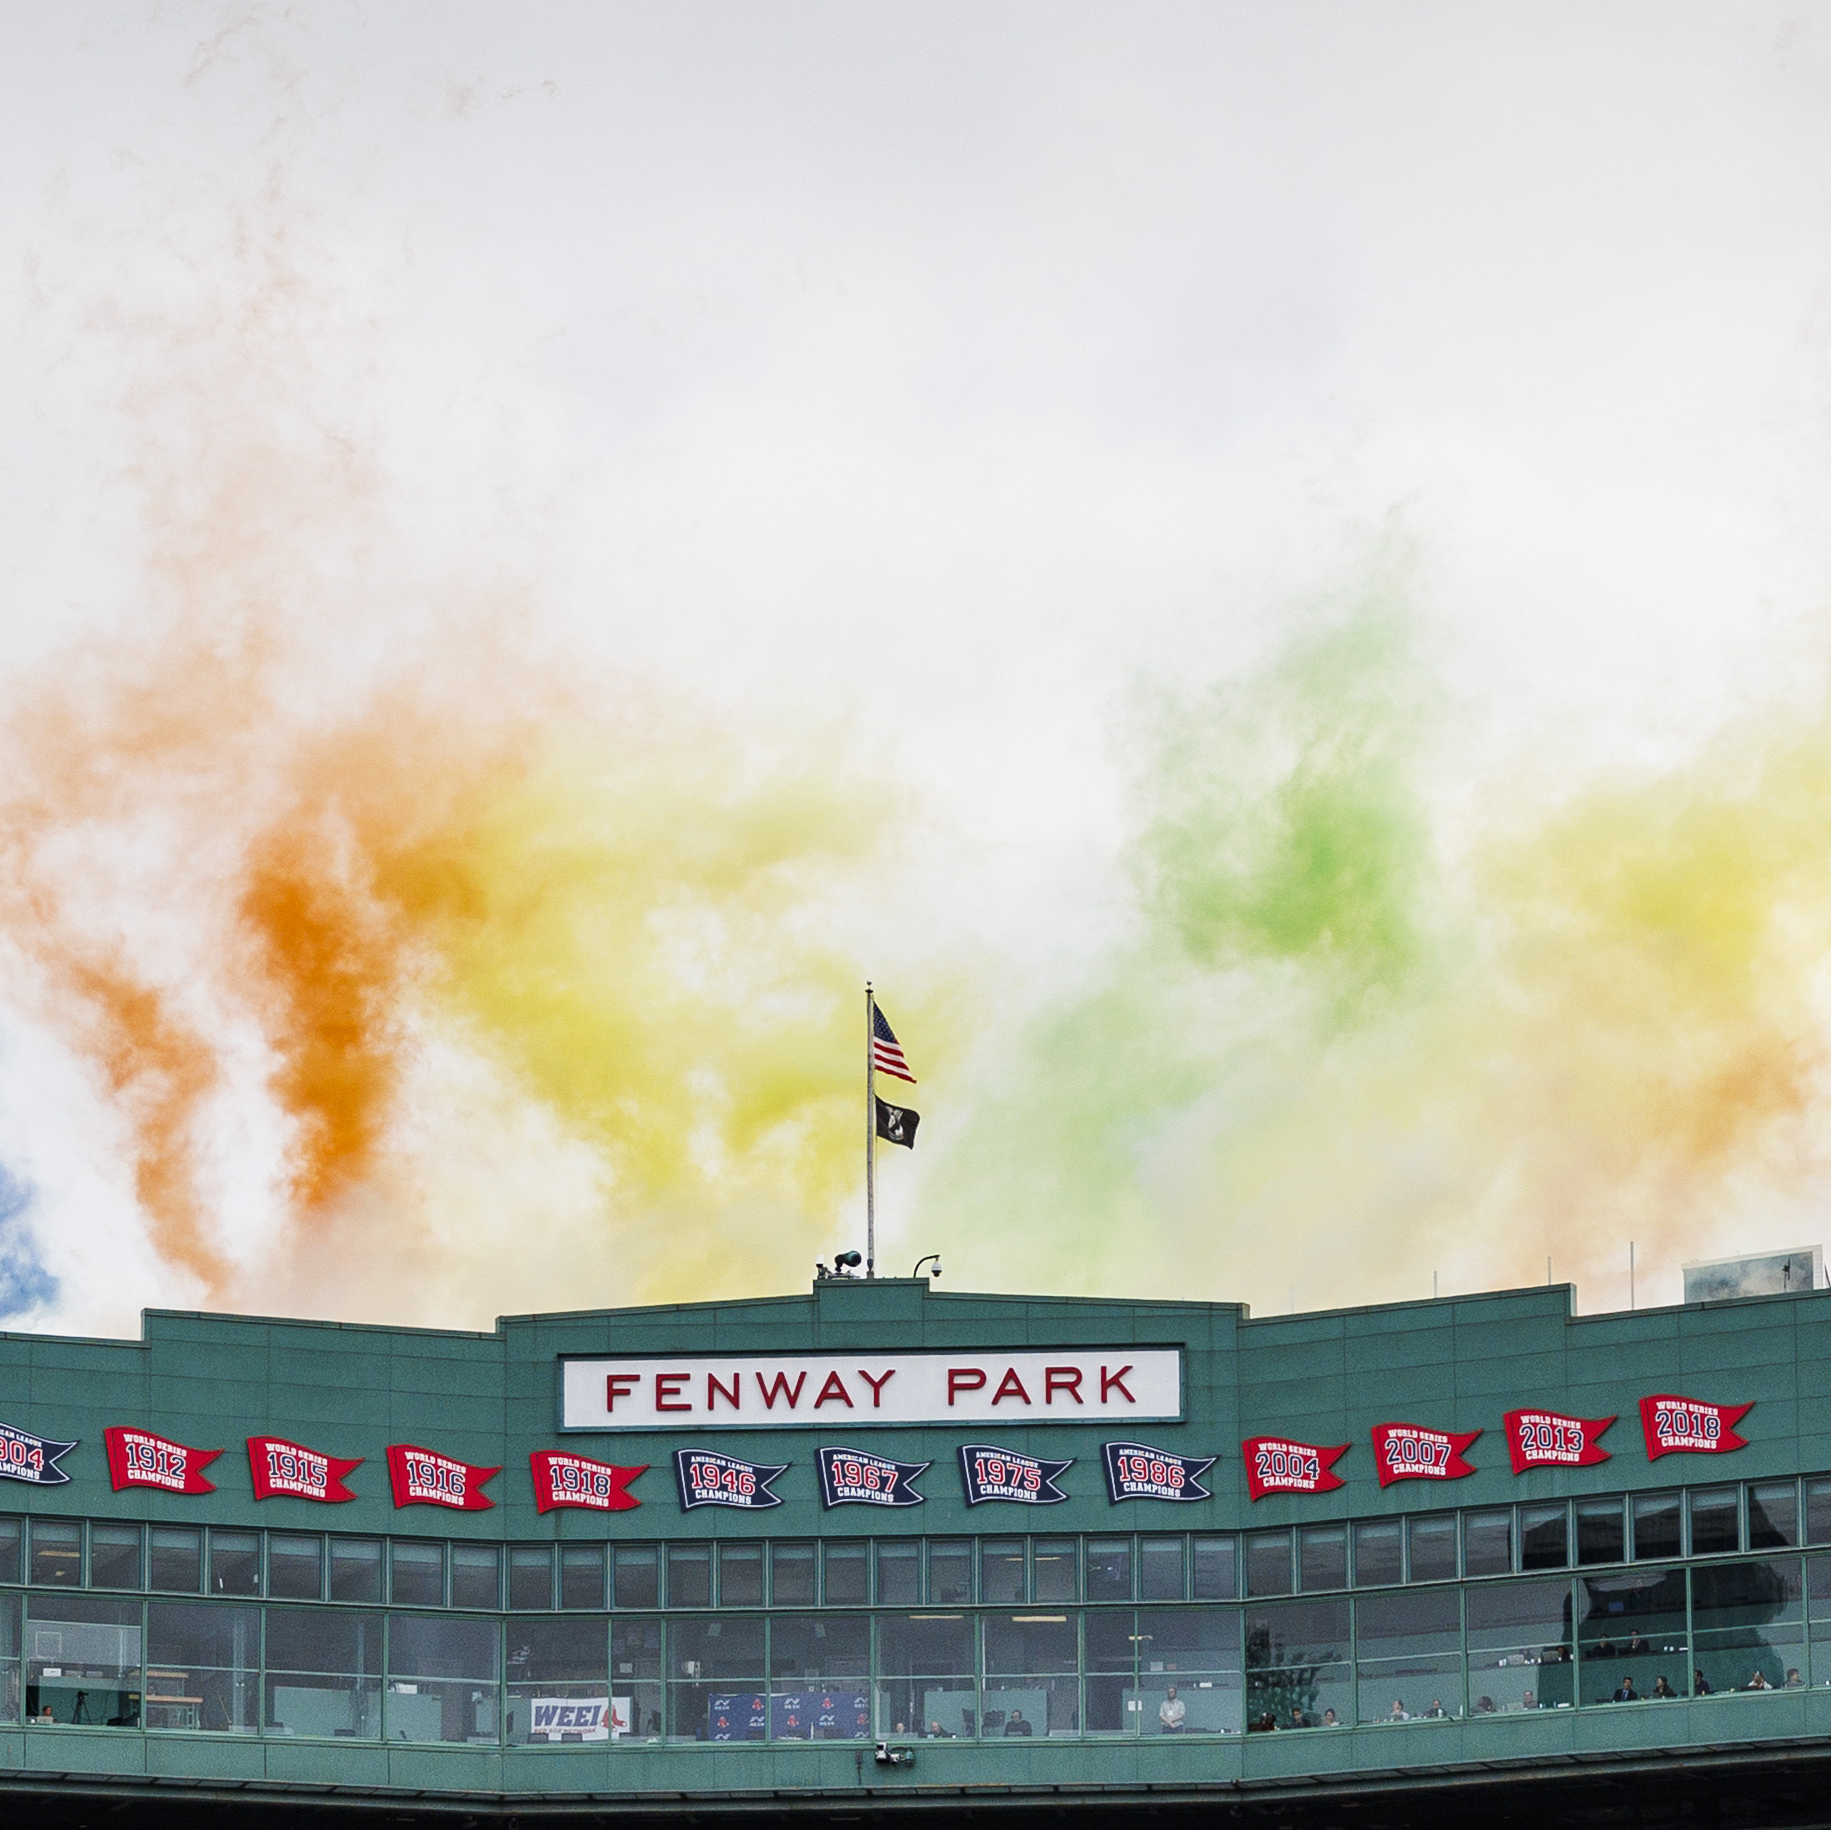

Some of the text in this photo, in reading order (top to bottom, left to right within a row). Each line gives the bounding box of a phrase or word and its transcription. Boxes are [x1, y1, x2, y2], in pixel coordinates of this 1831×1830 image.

[607, 1365, 1137, 1412] FENWAY PARK
[1656, 1401, 1719, 1417] WORLD SERIES
[1520, 1415, 1581, 1430] WORLD SERIES
[1655, 1411, 1721, 1440] 2018
[16, 1431, 42, 1448] LEAGUE
[123, 1433, 187, 1457] WORLD SERIES
[1387, 1428, 1448, 1444] WORLD SERIES
[1519, 1424, 1584, 1452] 2013
[1661, 1436, 1717, 1450] CHAMPIONS
[265, 1442, 328, 1466] WORLD SERIES
[1119, 1448, 1182, 1466] AMERICAN LEAGUE
[1257, 1442, 1317, 1457] WORLD SERIES
[1384, 1438, 1452, 1468] 2007
[1525, 1450, 1580, 1463] CHAMPIONS
[125, 1444, 186, 1481] 1912
[267, 1452, 328, 1488] 1915
[404, 1451, 466, 1474] WORLD SERIES
[548, 1456, 611, 1476] WORLD SERIES
[691, 1455, 753, 1474] AMERICAN LEAGUE
[832, 1453, 896, 1471] AMERICAN LEAGUE
[975, 1451, 1039, 1469] AMERICAN LEAGUE
[1255, 1452, 1320, 1481] 2004
[1393, 1462, 1446, 1477] CHAMPIONS
[127, 1469, 185, 1490] CHAMPIONS
[406, 1461, 466, 1496] 1916
[550, 1465, 611, 1497] 1918
[690, 1464, 757, 1496] 1946
[831, 1462, 899, 1493] 1967
[974, 1459, 1042, 1491] 1975
[1117, 1455, 1186, 1488] 1986
[270, 1477, 326, 1498] CHAMPIONS
[980, 1484, 1038, 1501] CHAMPIONS
[1123, 1482, 1181, 1498] CHAMPIONS
[1263, 1476, 1315, 1490] CHAMPIONS
[409, 1486, 465, 1506] CHAMPIONS
[552, 1490, 609, 1507] CHAMPIONS
[695, 1489, 752, 1505] CHAMPIONS
[837, 1487, 894, 1503] CHAMPIONS
[534, 1705, 602, 1727] WEEI
